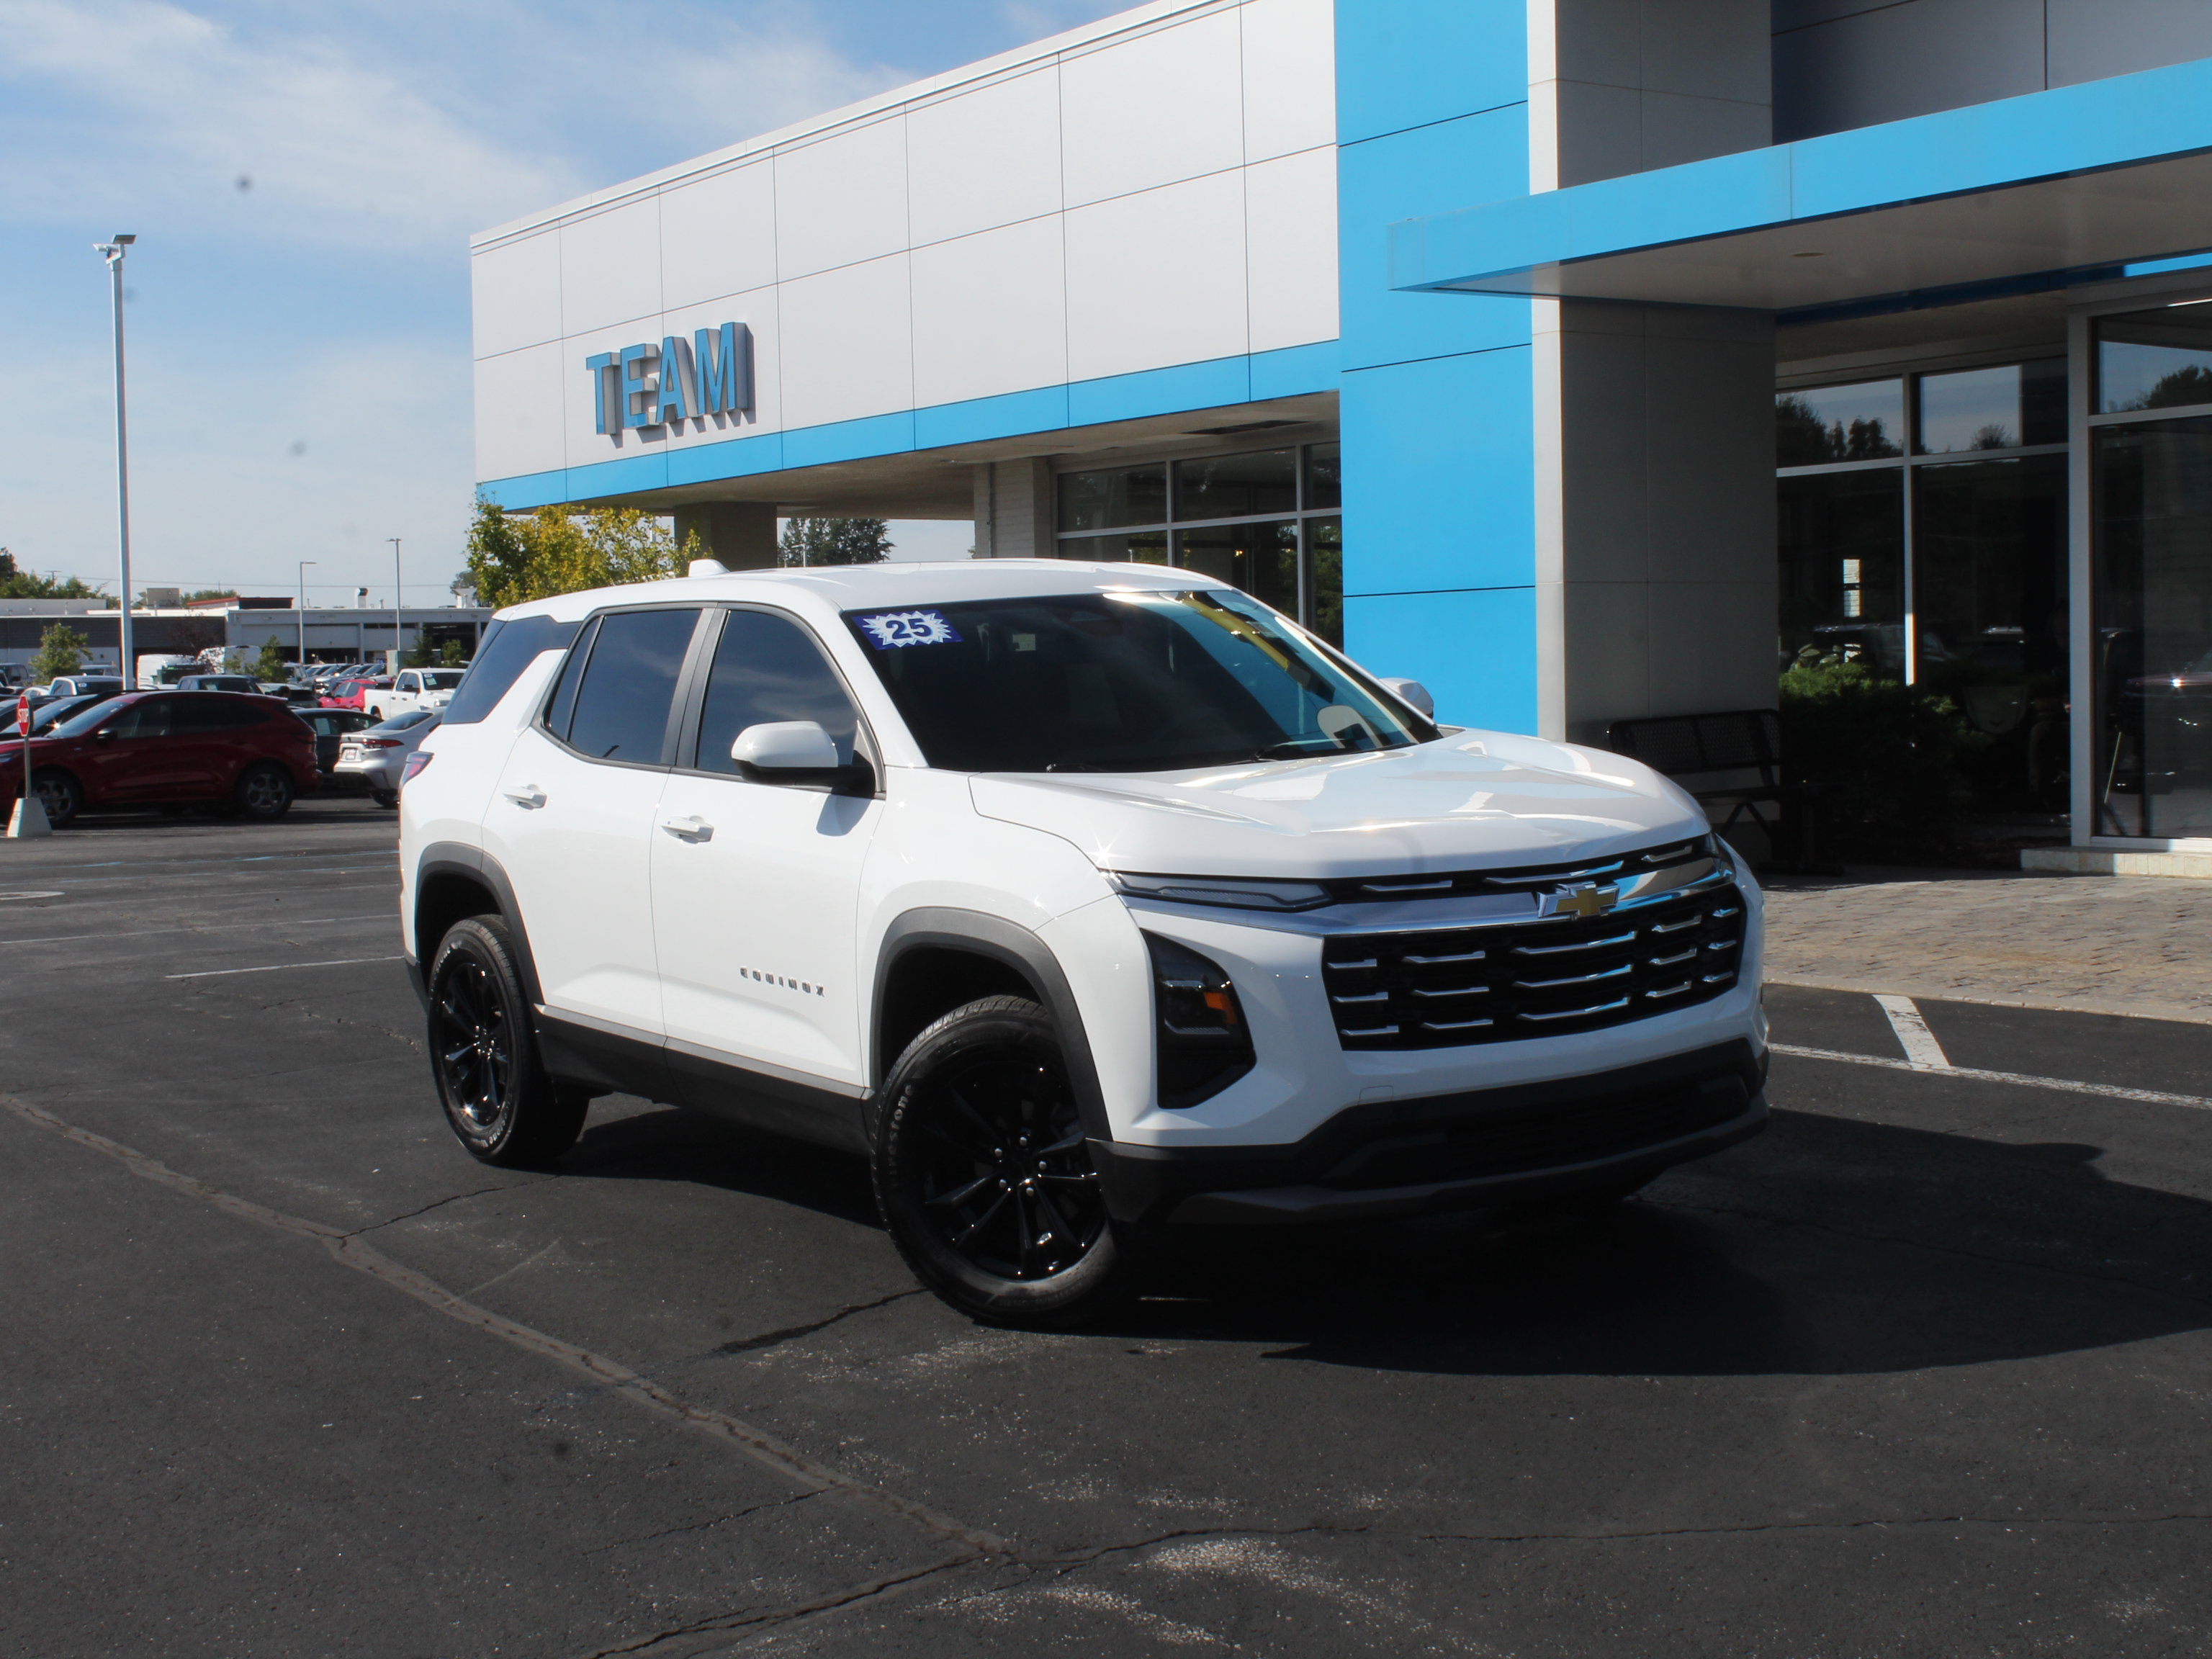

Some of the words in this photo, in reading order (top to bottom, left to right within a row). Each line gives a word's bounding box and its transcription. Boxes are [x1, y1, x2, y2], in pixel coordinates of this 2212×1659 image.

[585, 321, 749, 435] TEAM
[885, 618, 933, 639] 25
[18, 708, 29, 723] STOP
